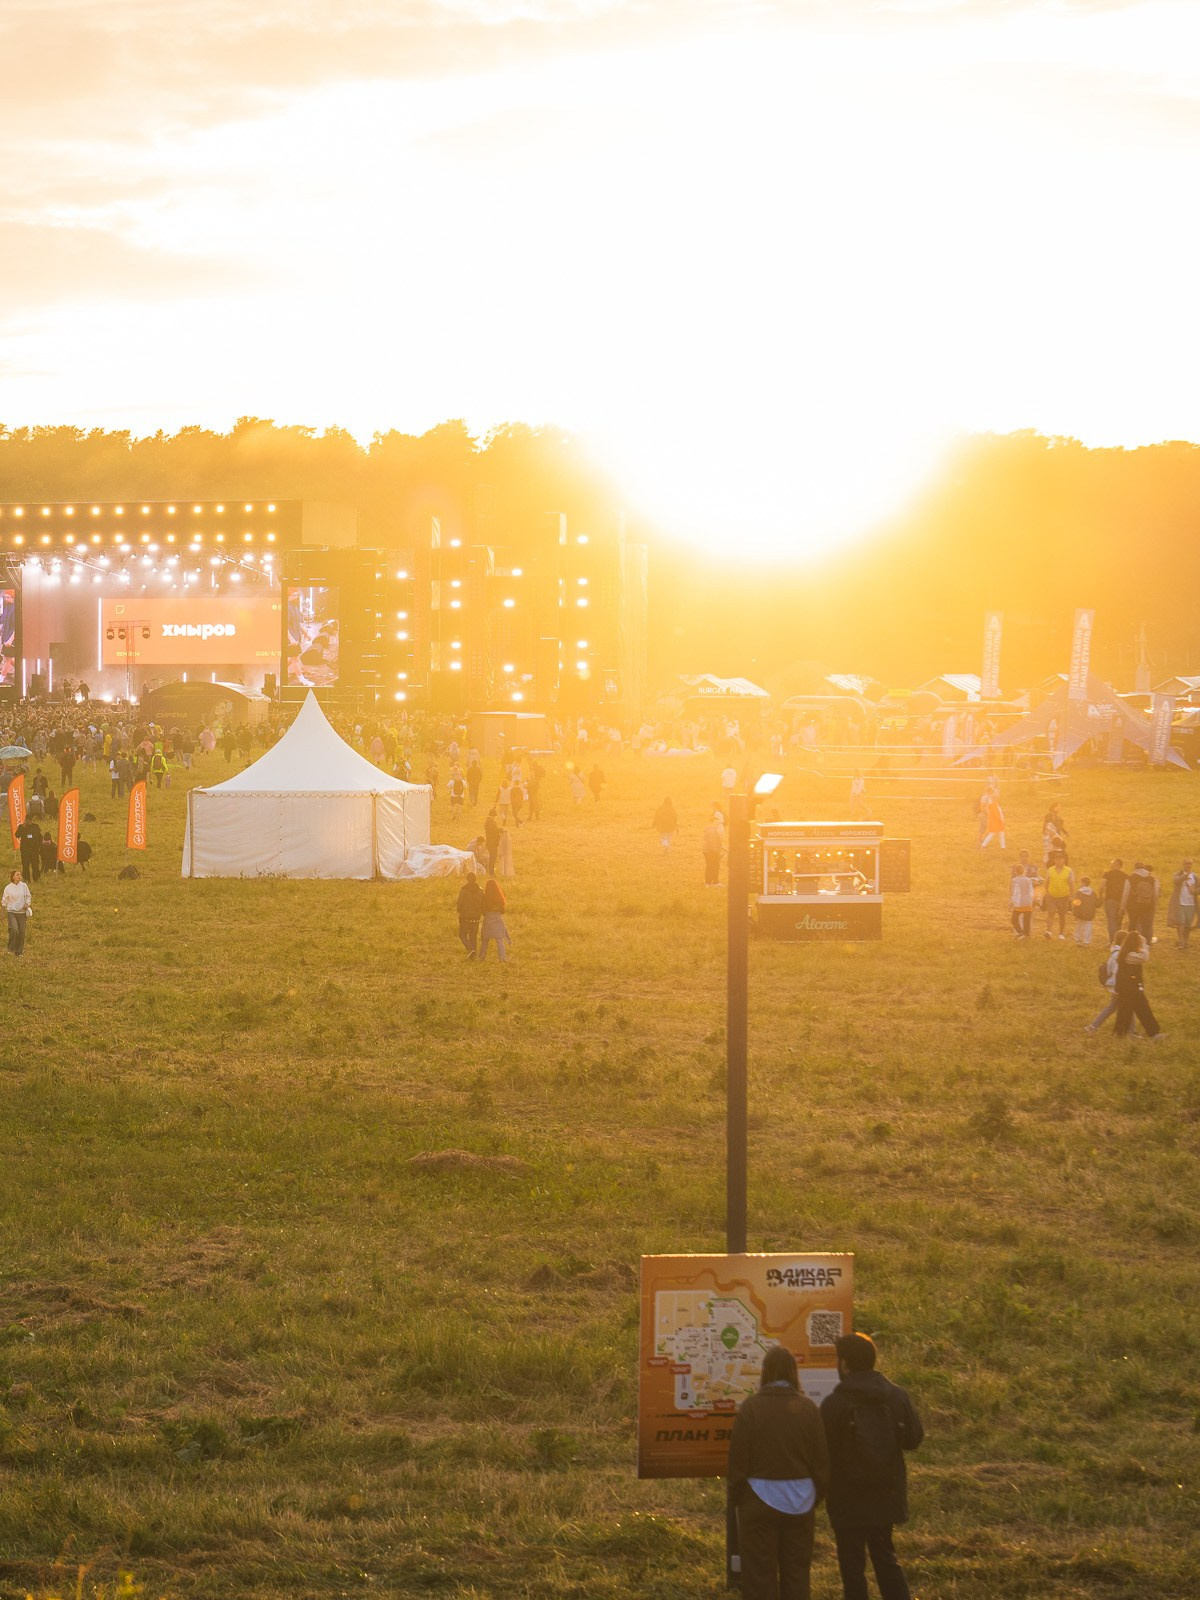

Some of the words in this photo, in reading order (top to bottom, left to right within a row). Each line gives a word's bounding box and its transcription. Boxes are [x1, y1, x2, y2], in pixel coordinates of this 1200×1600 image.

[12, 788, 21, 827] УЗТОРГ
[64, 800, 73, 846] МУЗТОРГ
[795, 913, 849, 931] Alcreme
[783, 1267, 842, 1278] ДИКАЯ
[787, 1278, 835, 1287] МЯТА
[656, 1429, 709, 1442] ПЛАН
